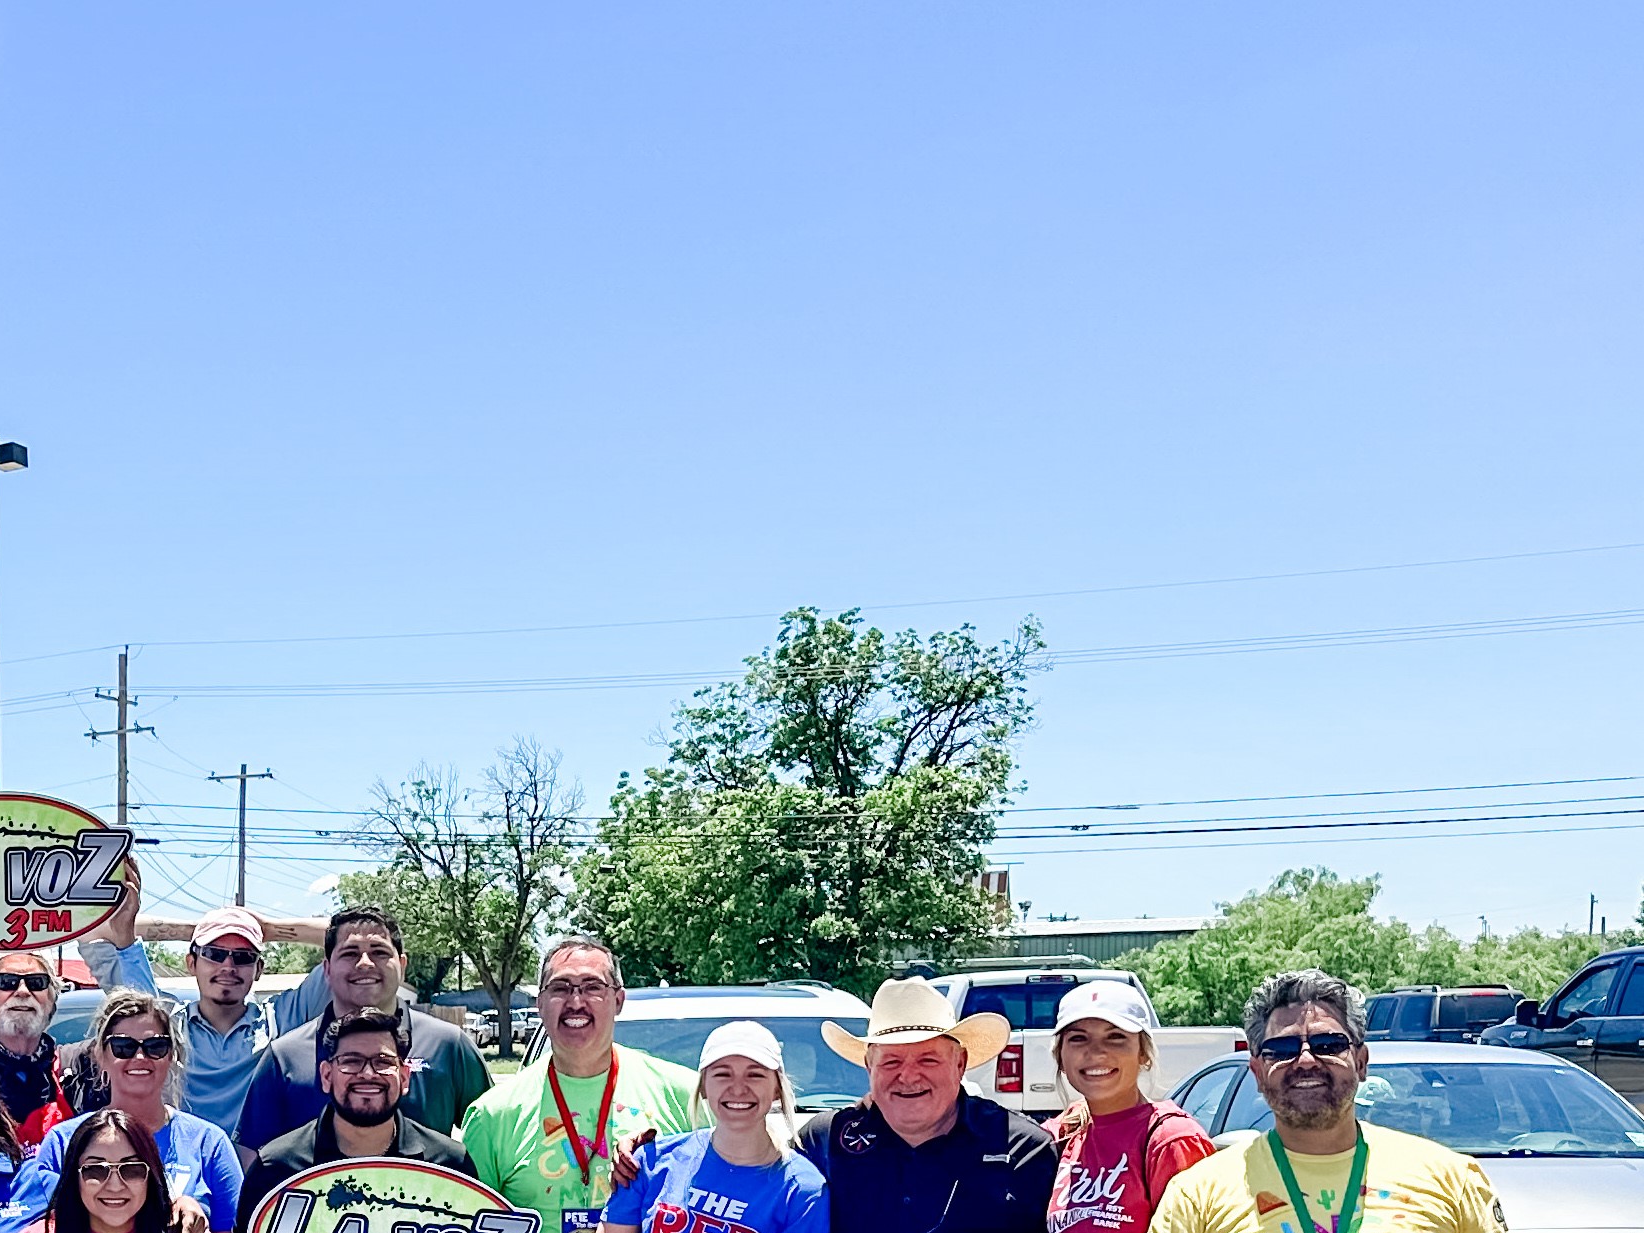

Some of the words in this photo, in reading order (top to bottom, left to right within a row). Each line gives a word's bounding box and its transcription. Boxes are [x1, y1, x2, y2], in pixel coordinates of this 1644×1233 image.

[5, 829, 134, 905] VOZ
[31, 909, 72, 933] FM
[564, 1211, 589, 1223] PETE
[687, 1186, 749, 1221] THE
